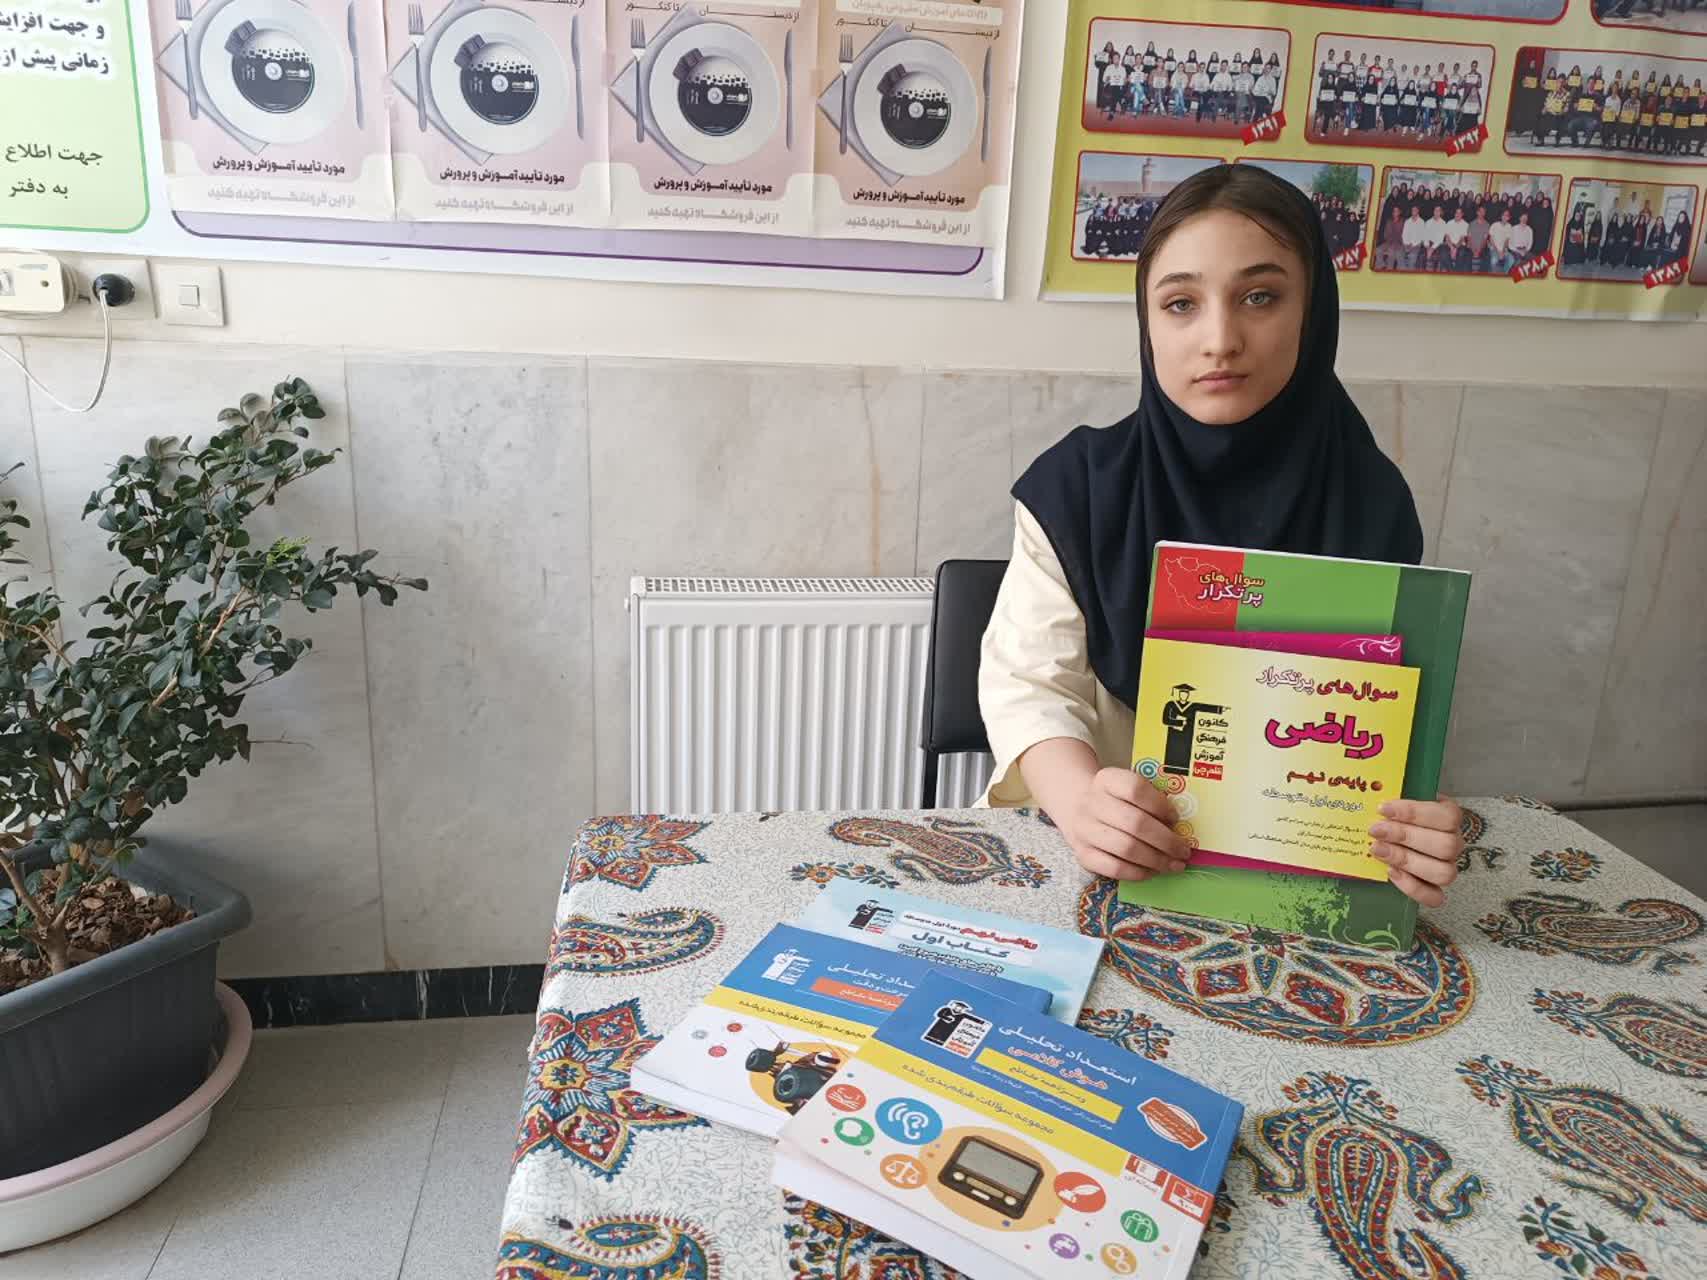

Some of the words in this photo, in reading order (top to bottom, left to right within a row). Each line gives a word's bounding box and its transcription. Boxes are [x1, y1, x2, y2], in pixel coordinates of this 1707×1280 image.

[49, 18, 88, 37] جهت
[96, 24, 105, 40] و
[2, 48, 16, 67] از
[22, 49, 56, 71] پیش
[62, 52, 109, 74] زمانی
[5, 143, 52, 162] اطلاع
[58, 148, 103, 166] جهت
[212, 156, 246, 170] پرورش
[254, 159, 296, 172] آموزش
[323, 164, 345, 176] مورد
[440, 167, 471, 181] پرورش
[478, 169, 518, 182] آموزش
[544, 173, 565, 185] مورد
[8, 178, 46, 197] دفتر
[653, 177, 683, 191] پرورش
[691, 179, 728, 192] آموزش
[752, 183, 772, 195] مورد
[52, 184, 68, 199] به
[853, 188, 882, 201] پرورش
[888, 190, 924, 203] آموزش
[947, 194, 965, 206] مورد
[1255, 665, 1315, 695] پرتکرار
[1198, 718, 1229, 728] کانون
[1196, 733, 1226, 746] فرهنگی
[1264, 711, 1384, 760] ریاضی
[1194, 749, 1225, 762] آموزش
[1286, 771, 1326, 785] نهم
[912, 932, 945, 945] اول
[947, 940, 1011, 959] کتاب
[827, 963, 886, 980] تحلیلی
[998, 1025, 1064, 1051] تحلیلی
[1065, 1050, 1137, 1086] استعداد
[1059, 1066, 1109, 1090] هوش
[1015, 1112, 1056, 1135] مجموعه
